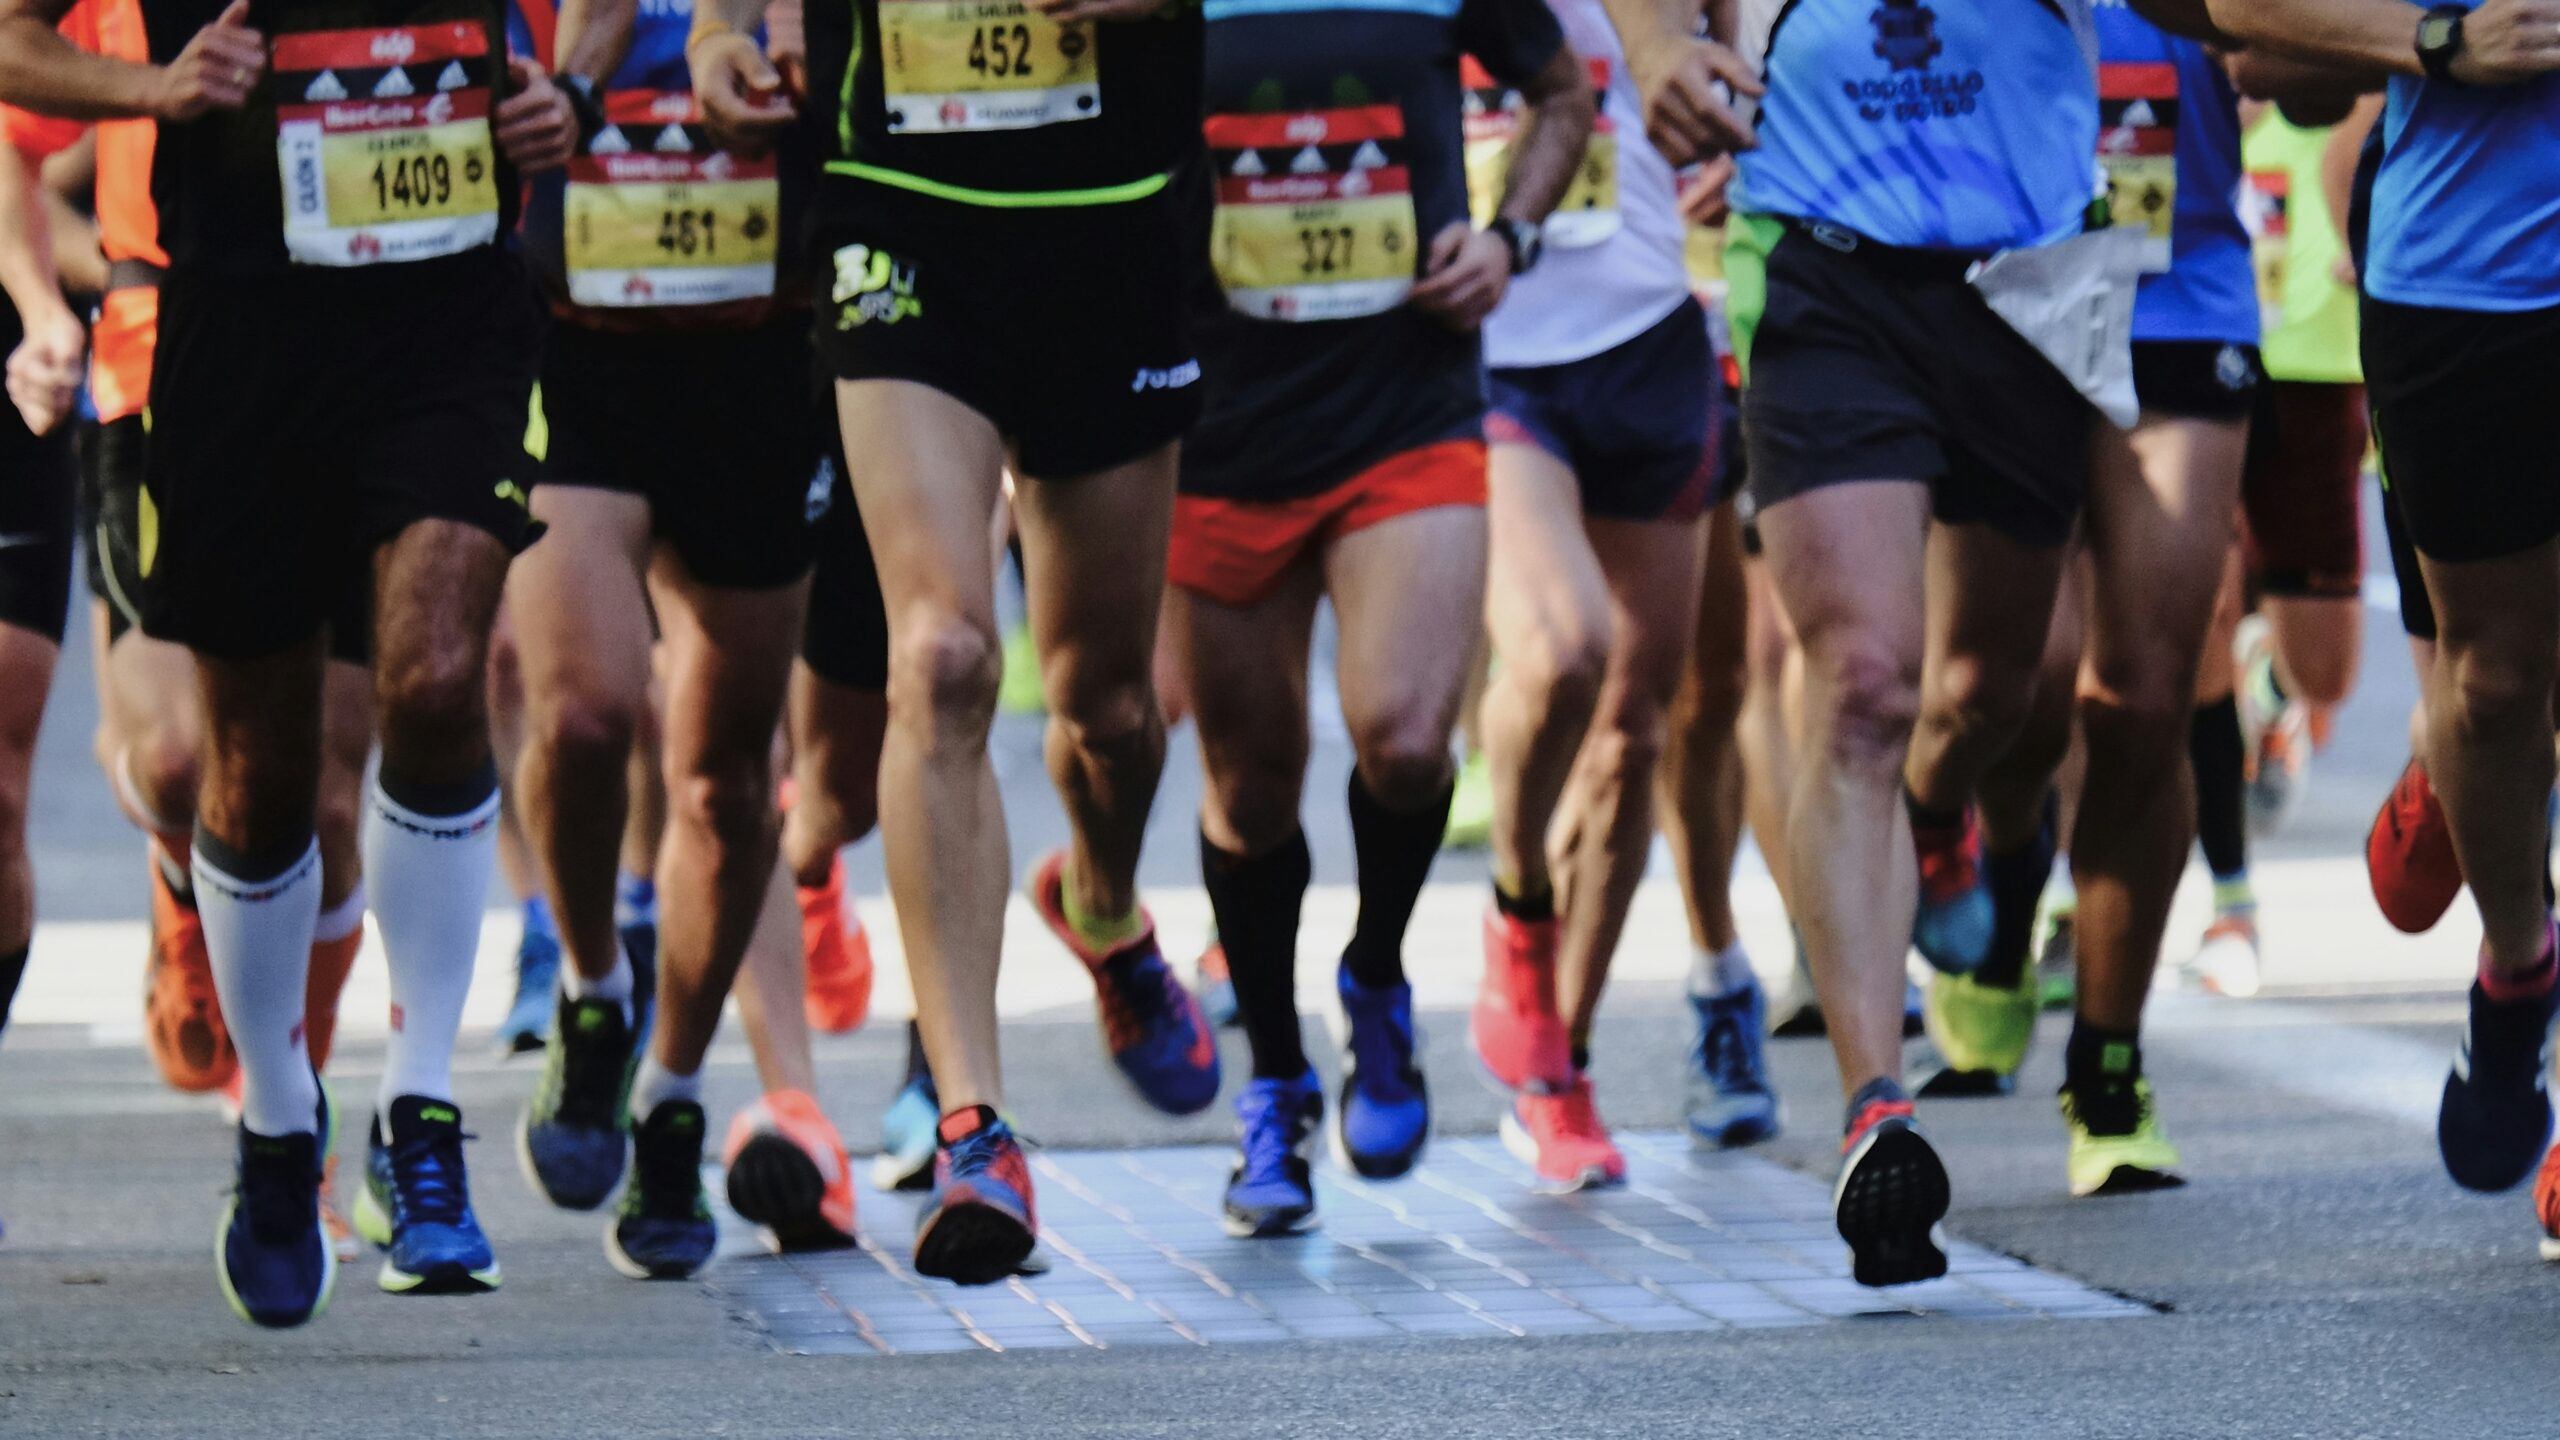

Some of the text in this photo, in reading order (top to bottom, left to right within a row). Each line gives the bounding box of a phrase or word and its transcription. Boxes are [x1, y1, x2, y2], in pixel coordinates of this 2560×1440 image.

[968, 24, 1034, 78] 452
[371, 152, 452, 212] 1409
[657, 208, 716, 256] 461
[1301, 226, 1355, 273] 327
